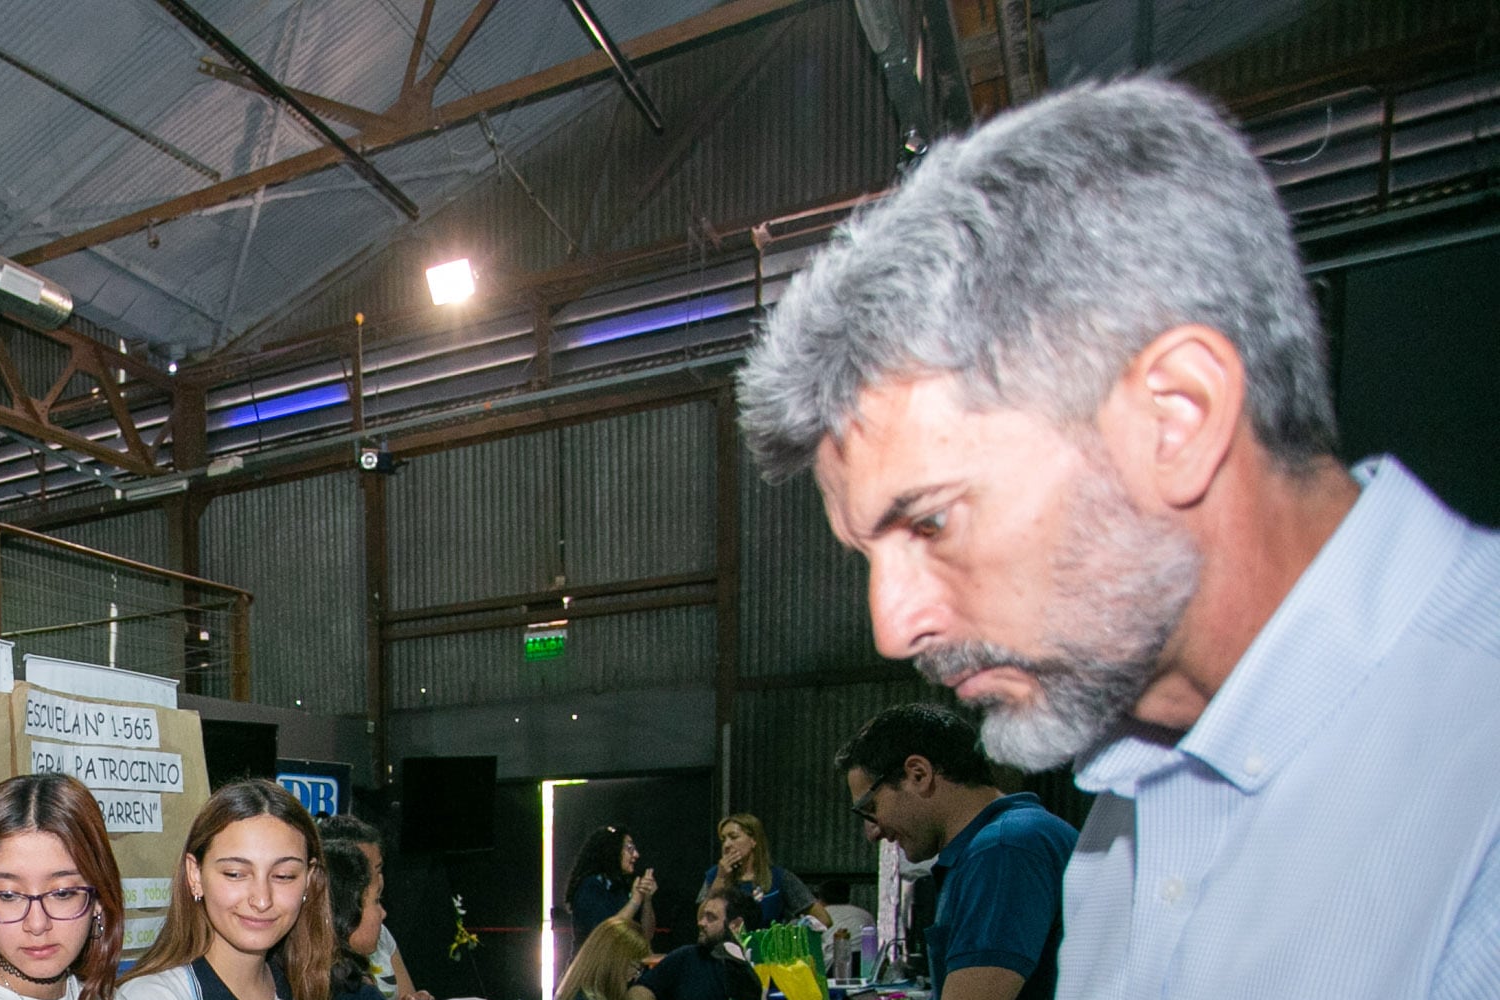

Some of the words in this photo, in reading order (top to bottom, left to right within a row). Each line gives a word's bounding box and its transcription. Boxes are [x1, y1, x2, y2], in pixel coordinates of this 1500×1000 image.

[26, 699, 82, 735] ESCUELA
[111, 716, 153, 741] 1-565
[75, 757, 180, 786] PATROCINIO
